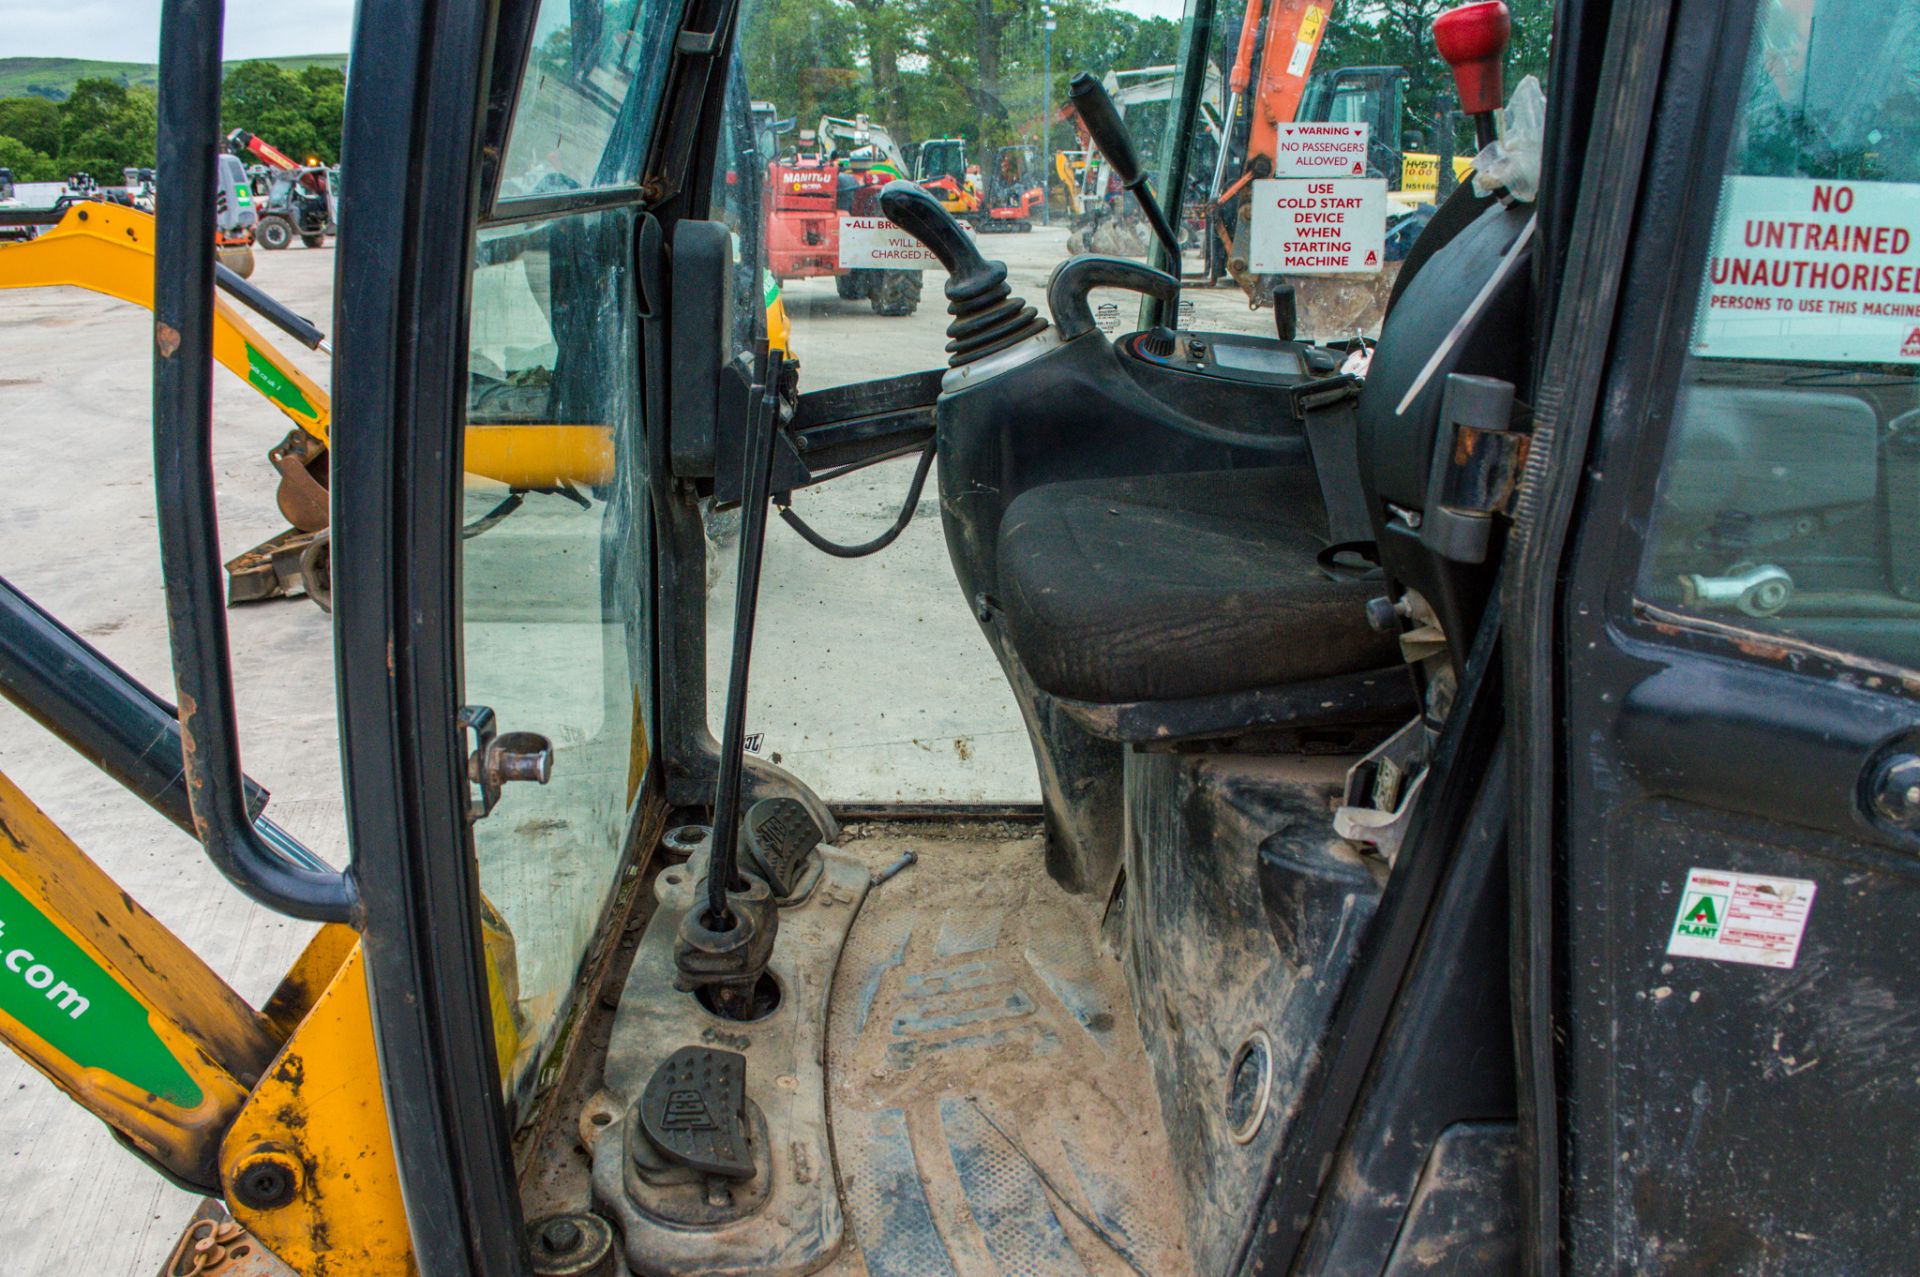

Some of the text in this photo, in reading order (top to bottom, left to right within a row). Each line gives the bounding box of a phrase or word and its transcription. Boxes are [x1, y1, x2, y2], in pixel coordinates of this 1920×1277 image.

[1298, 127, 1350, 136] WARNING
[1281, 143, 1365, 153] NO PASSENGERS
[1295, 156, 1348, 166] ALLOWED
[1308, 183, 1334, 194] USE
[1277, 198, 1363, 209] COLD START
[1811, 184, 1854, 214] NO
[1294, 212, 1345, 223] DEVICE
[853, 220, 874, 229] ALL
[1296, 227, 1341, 238] WHEN
[1743, 219, 1910, 255] UNTRAINED
[888, 239, 913, 248] WILL
[1283, 241, 1352, 253] STARTING
[871, 249, 938, 260] CHARGED FO
[1285, 256, 1349, 267] MACHINE
[1710, 295, 1772, 311] PERSONS
[1777, 298, 1794, 312] TO
[1799, 299, 1824, 313] USE
[1828, 300, 1857, 315] THIS
[1684, 896, 1718, 925] A
[1677, 924, 1719, 938] PLANT
